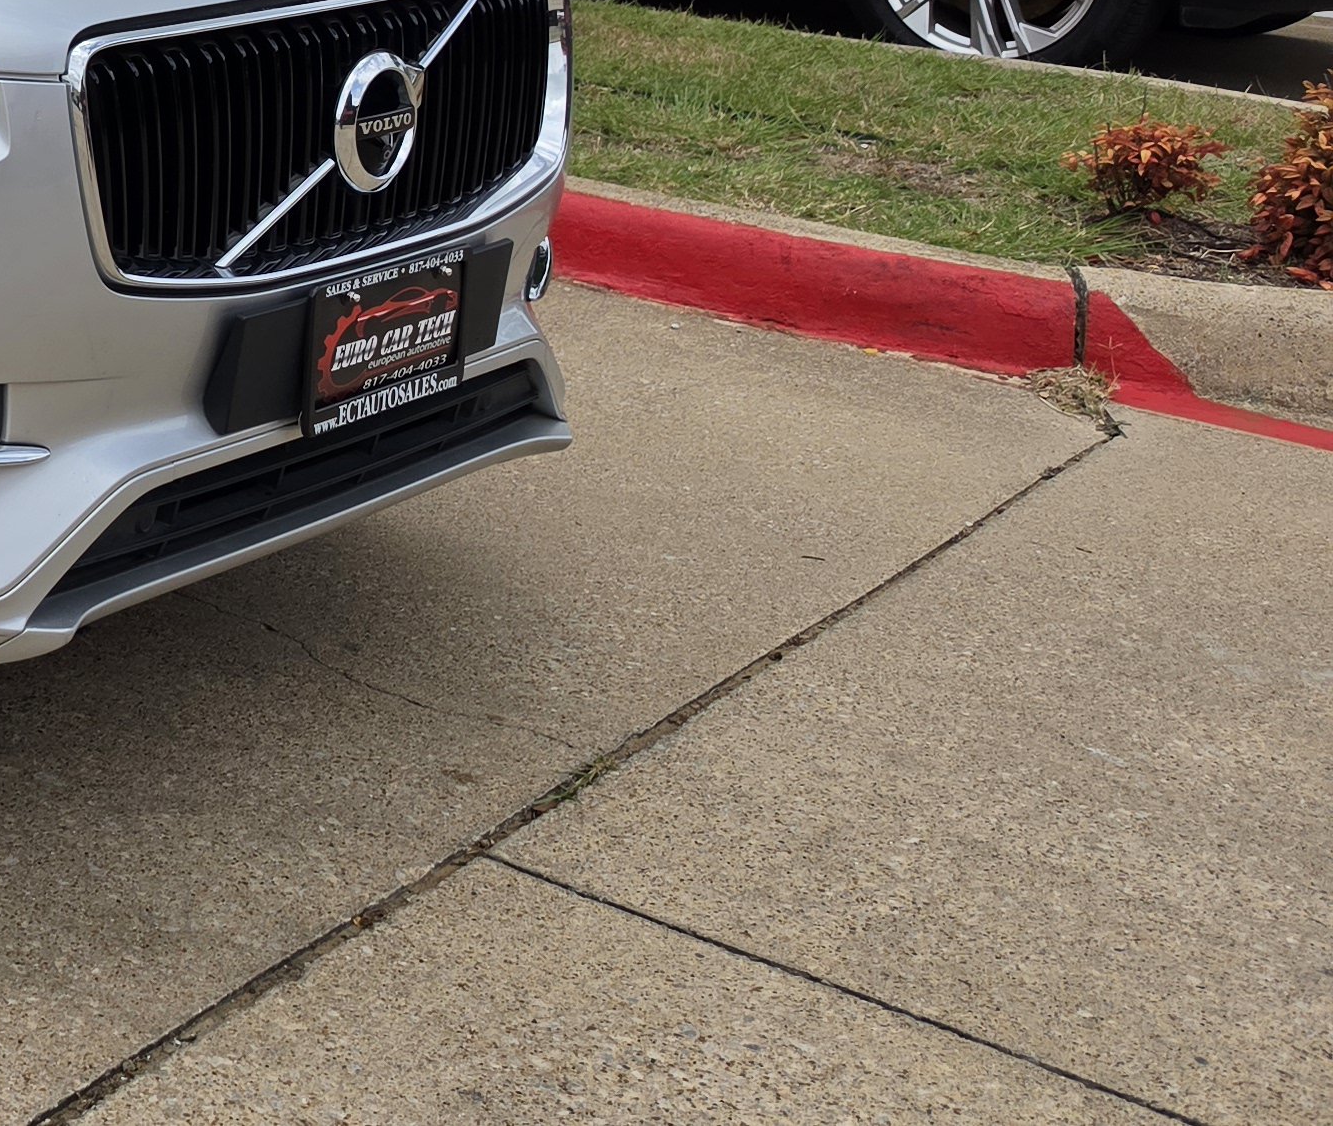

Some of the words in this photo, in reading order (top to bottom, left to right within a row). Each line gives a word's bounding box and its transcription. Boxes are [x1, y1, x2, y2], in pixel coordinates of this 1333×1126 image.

[359, 112, 412, 135] VOLVO
[325, 280, 352, 298] SALES
[353, 278, 360, 289] &
[361, 267, 399, 287] SERVICE
[408, 249, 464, 274] 817-404-4033
[331, 334, 378, 372] EURO
[380, 324, 414, 356] CAR
[415, 310, 456, 345] TECH
[367, 348, 407, 370] european
[407, 335, 452, 356] automotive
[363, 354, 448, 390] 817-404-4033
[313, 373, 458, 435] www.ECTAUTOSALES.com
